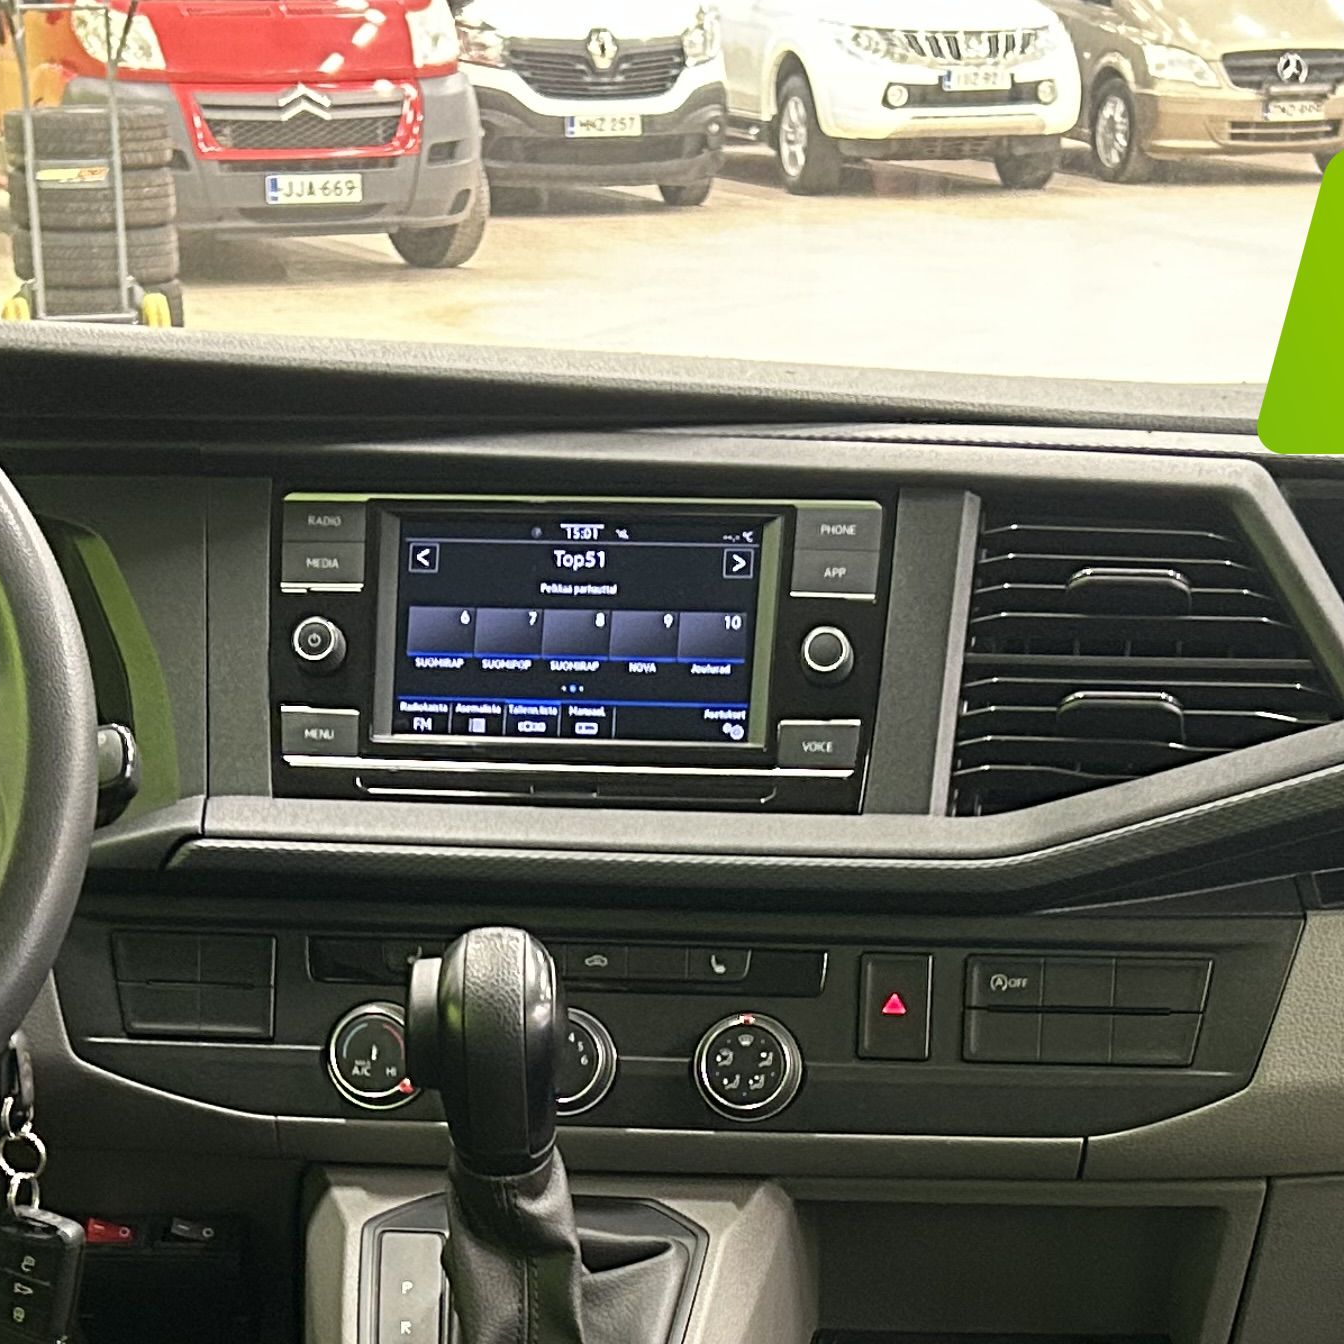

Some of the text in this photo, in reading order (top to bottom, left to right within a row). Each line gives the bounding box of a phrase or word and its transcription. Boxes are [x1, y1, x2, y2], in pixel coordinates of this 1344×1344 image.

[308, 515, 342, 526] RADIO
[820, 524, 856, 535] PHONE
[306, 557, 339, 569] MEDIA
[554, 550, 605, 571] Top51
[824, 567, 846, 578] APP
[460, 610, 471, 624] 6
[528, 611, 538, 626] 7
[595, 612, 605, 628] 8
[663, 613, 674, 628] 9
[724, 615, 742, 630] 10
[628, 662, 657, 673] NOVA
[413, 717, 433, 731] FM
[304, 728, 335, 740] MENU
[802, 741, 833, 753] VOICE
[568, 1032, 575, 1043] 4
[580, 1054, 589, 1066] 6
[351, 1066, 371, 1077] A/C
[401, 1280, 413, 1295] P
[400, 1320, 412, 1335] R
